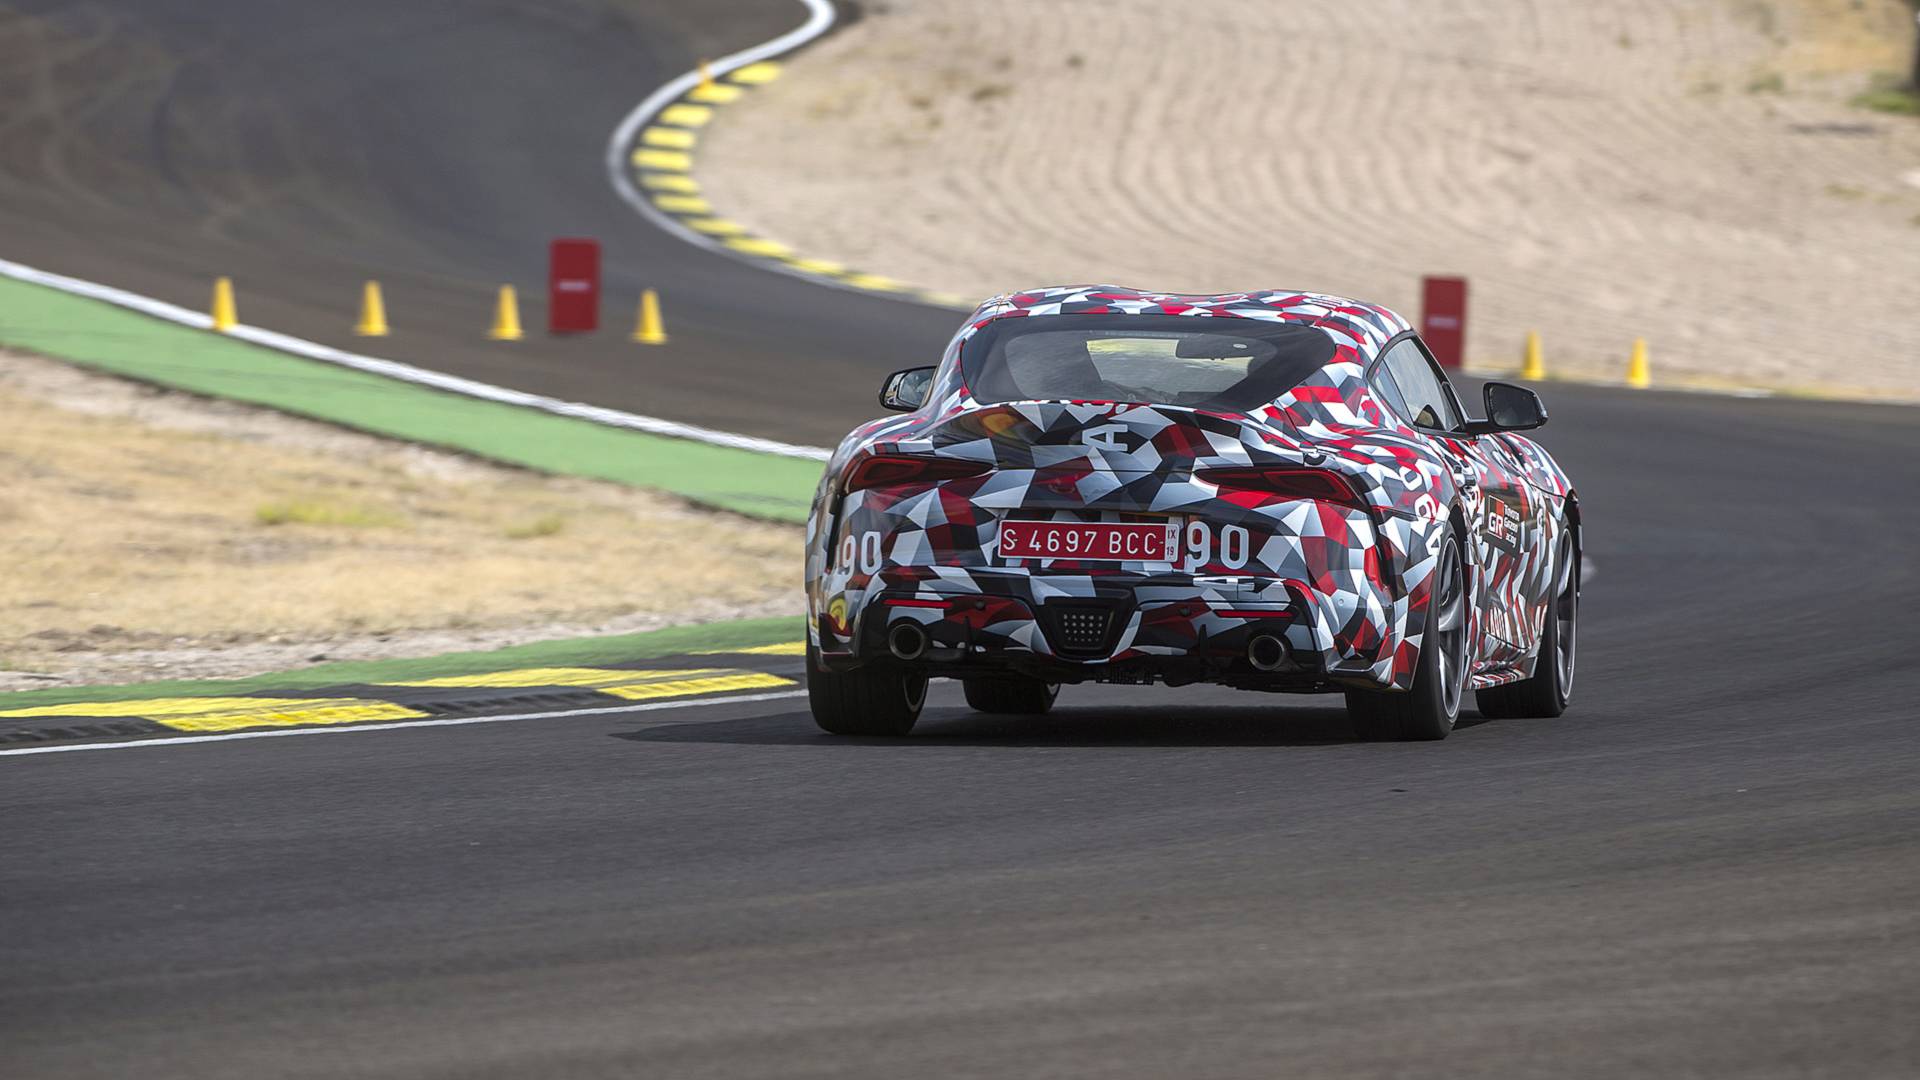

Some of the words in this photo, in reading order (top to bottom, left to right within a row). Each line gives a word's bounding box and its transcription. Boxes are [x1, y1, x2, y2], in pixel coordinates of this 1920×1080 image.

[1488, 511, 1504, 537] GR
[1029, 529, 1097, 553] 4697
[1108, 531, 1157, 555] BCC
